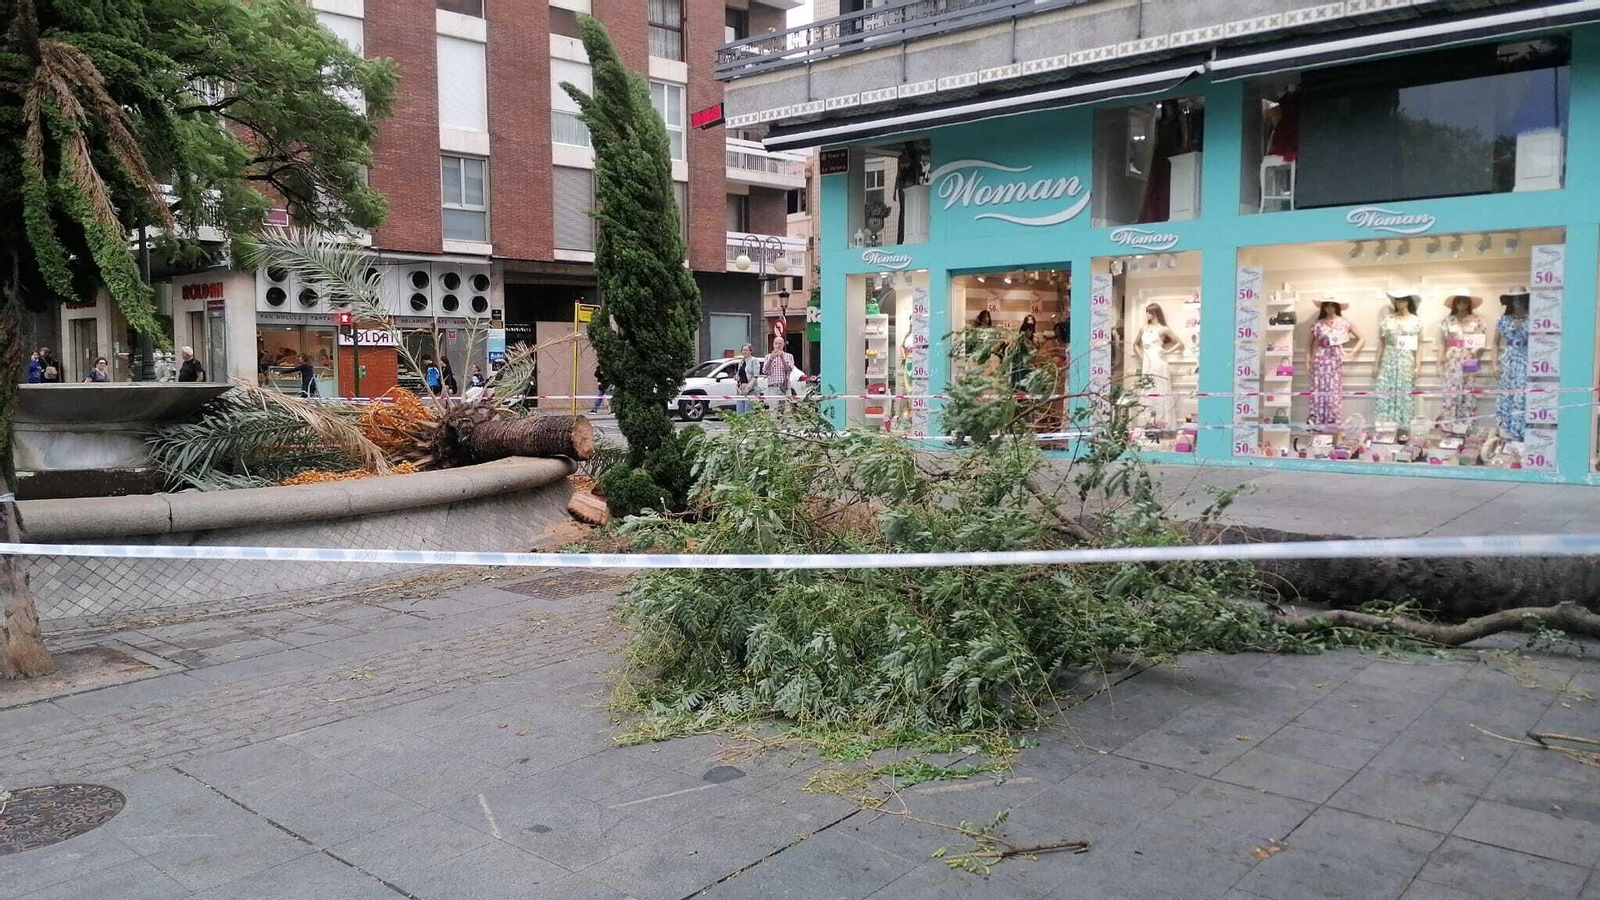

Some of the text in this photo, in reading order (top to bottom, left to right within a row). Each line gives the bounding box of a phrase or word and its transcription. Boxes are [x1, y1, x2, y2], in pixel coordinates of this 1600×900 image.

[935, 166, 1087, 214] Woman
[1347, 208, 1435, 230] Woman
[1111, 229, 1178, 248] Woman
[862, 250, 912, 267] Woman
[182, 282, 224, 300] ROLDAN
